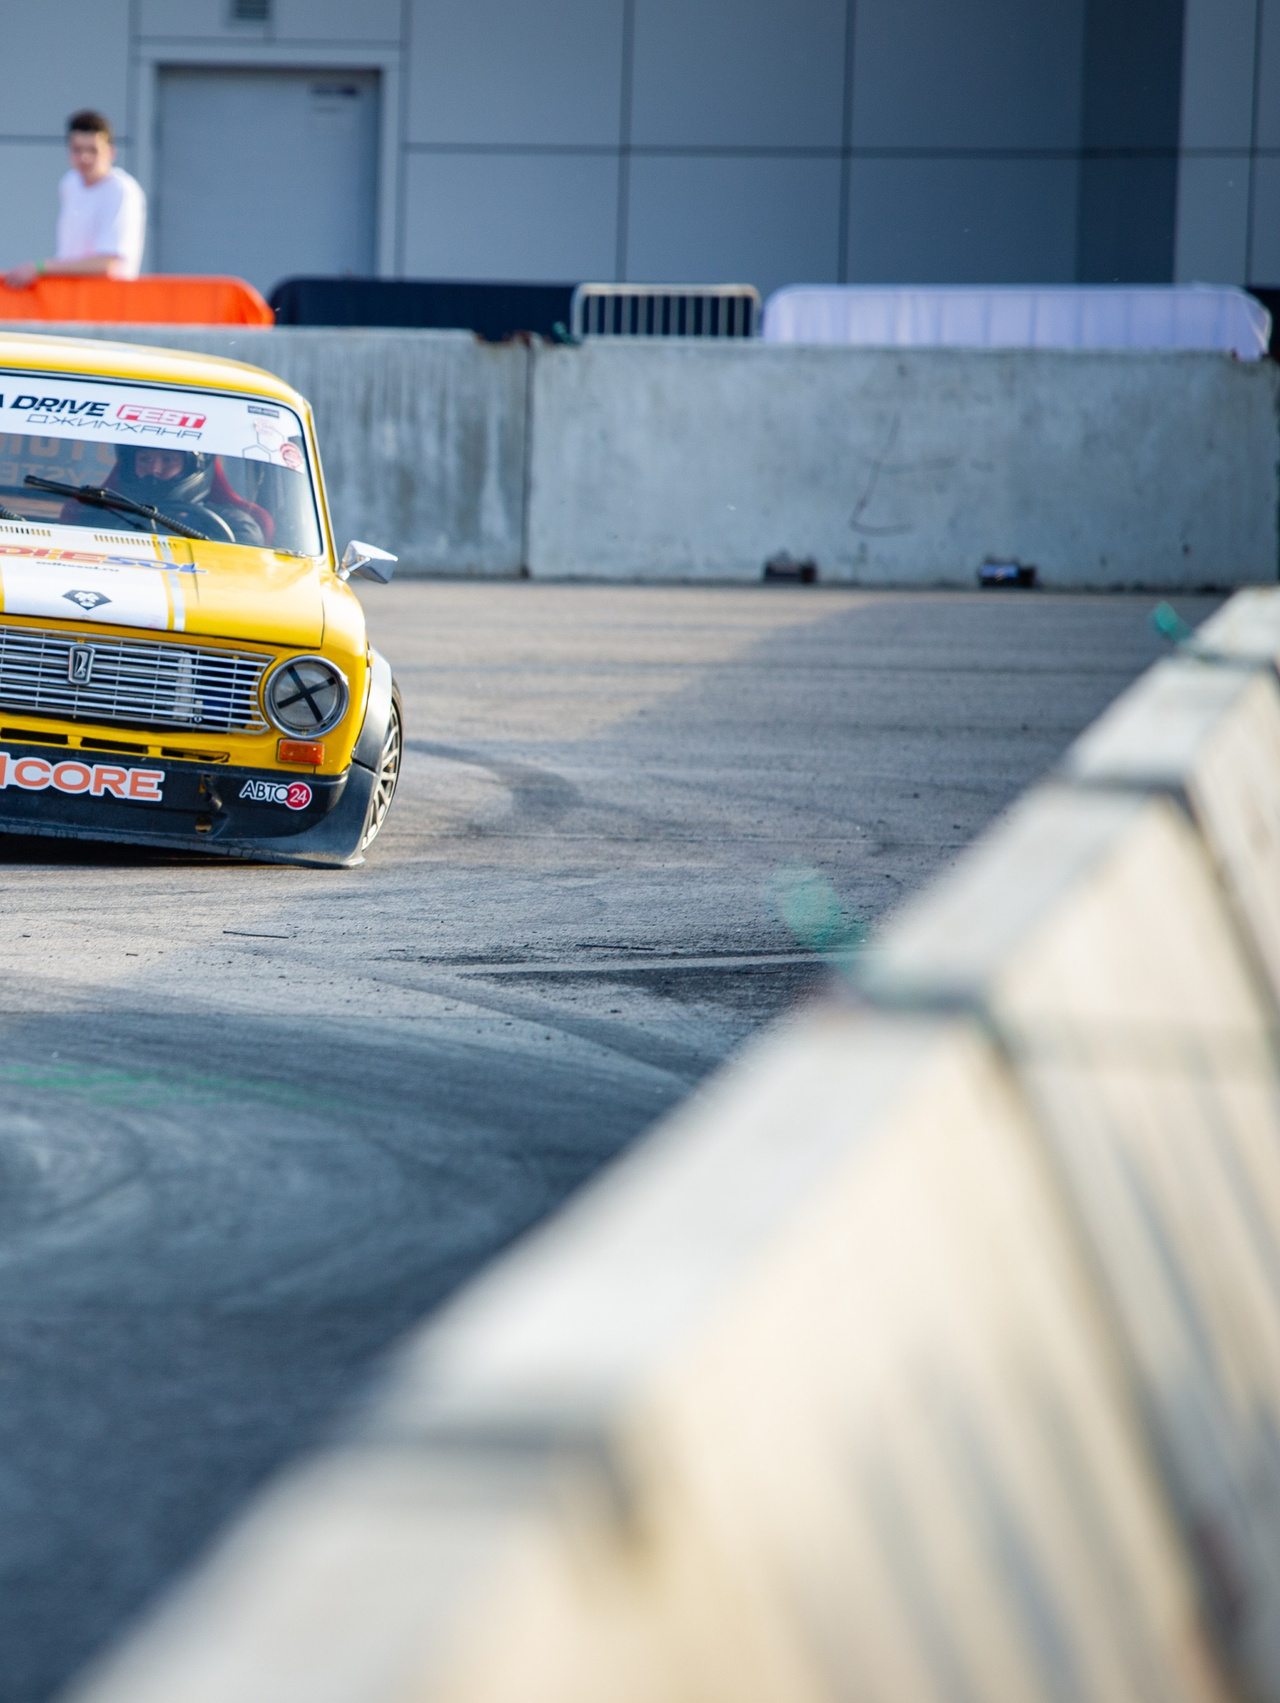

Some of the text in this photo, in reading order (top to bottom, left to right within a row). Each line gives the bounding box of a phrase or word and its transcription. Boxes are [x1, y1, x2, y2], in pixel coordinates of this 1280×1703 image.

[9, 394, 111, 418] DRIVE
[118, 405, 206, 428] FEST
[26, 413, 203, 441] ДЖИМХАНА
